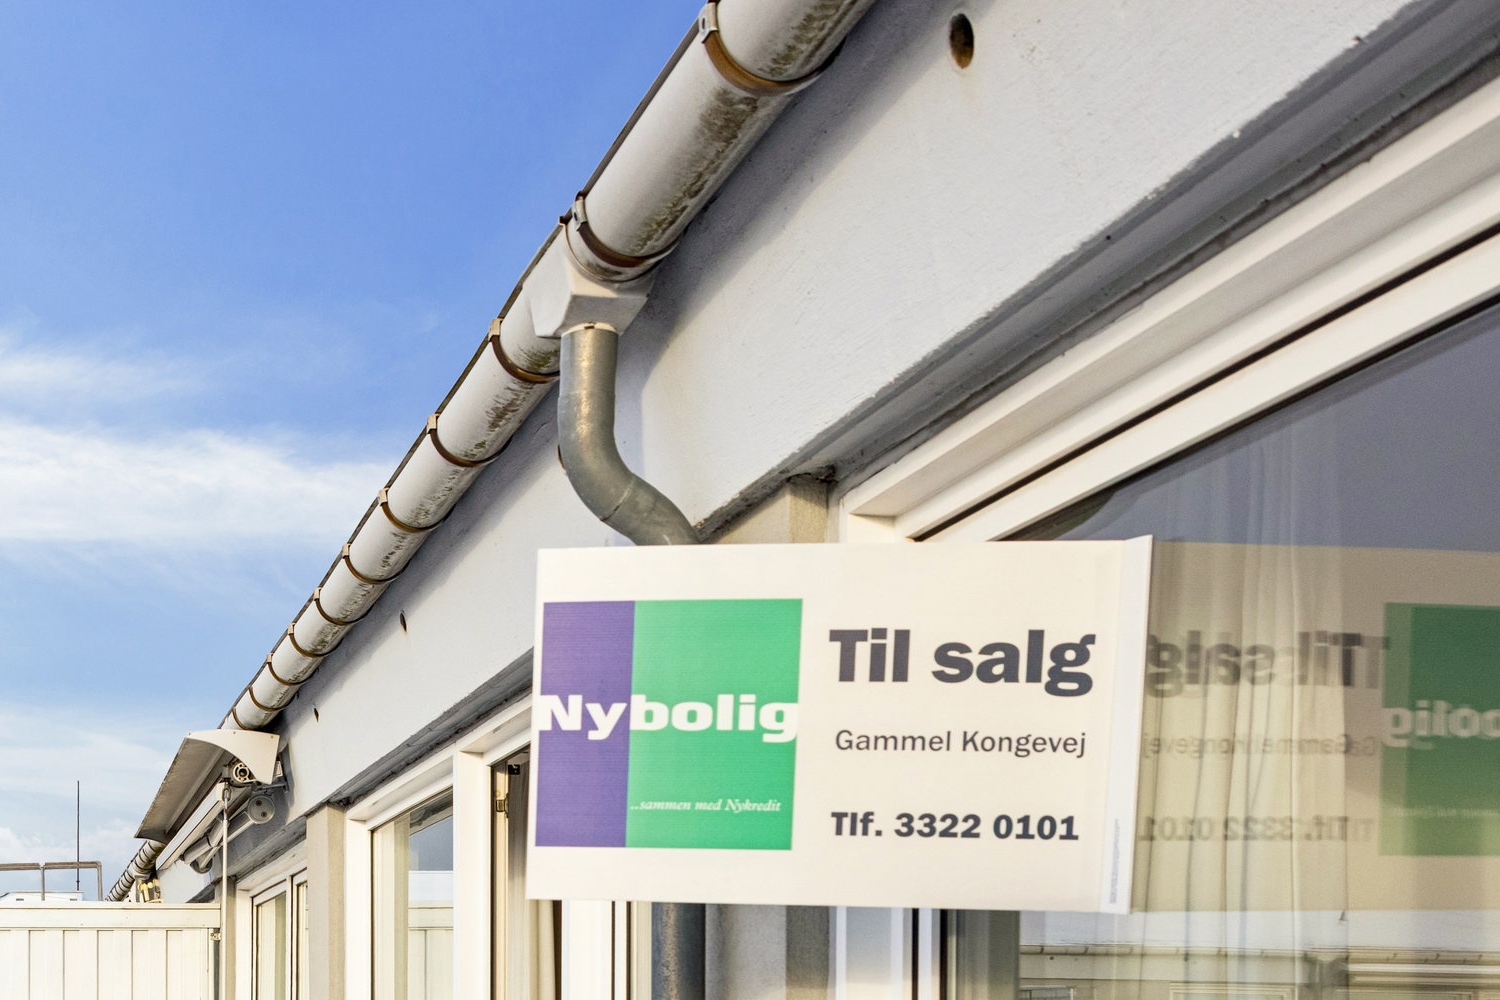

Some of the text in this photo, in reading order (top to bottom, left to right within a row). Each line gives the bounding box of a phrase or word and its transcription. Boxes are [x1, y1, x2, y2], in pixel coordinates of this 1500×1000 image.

[829, 628, 1096, 697] Til salg
[539, 694, 798, 743] Nybolig
[836, 730, 1086, 759] Gammel Kongevej
[695, 798, 722, 811] med
[725, 798, 781, 814] Nykredit
[831, 812, 1079, 840] Tlf. 3322 0101
